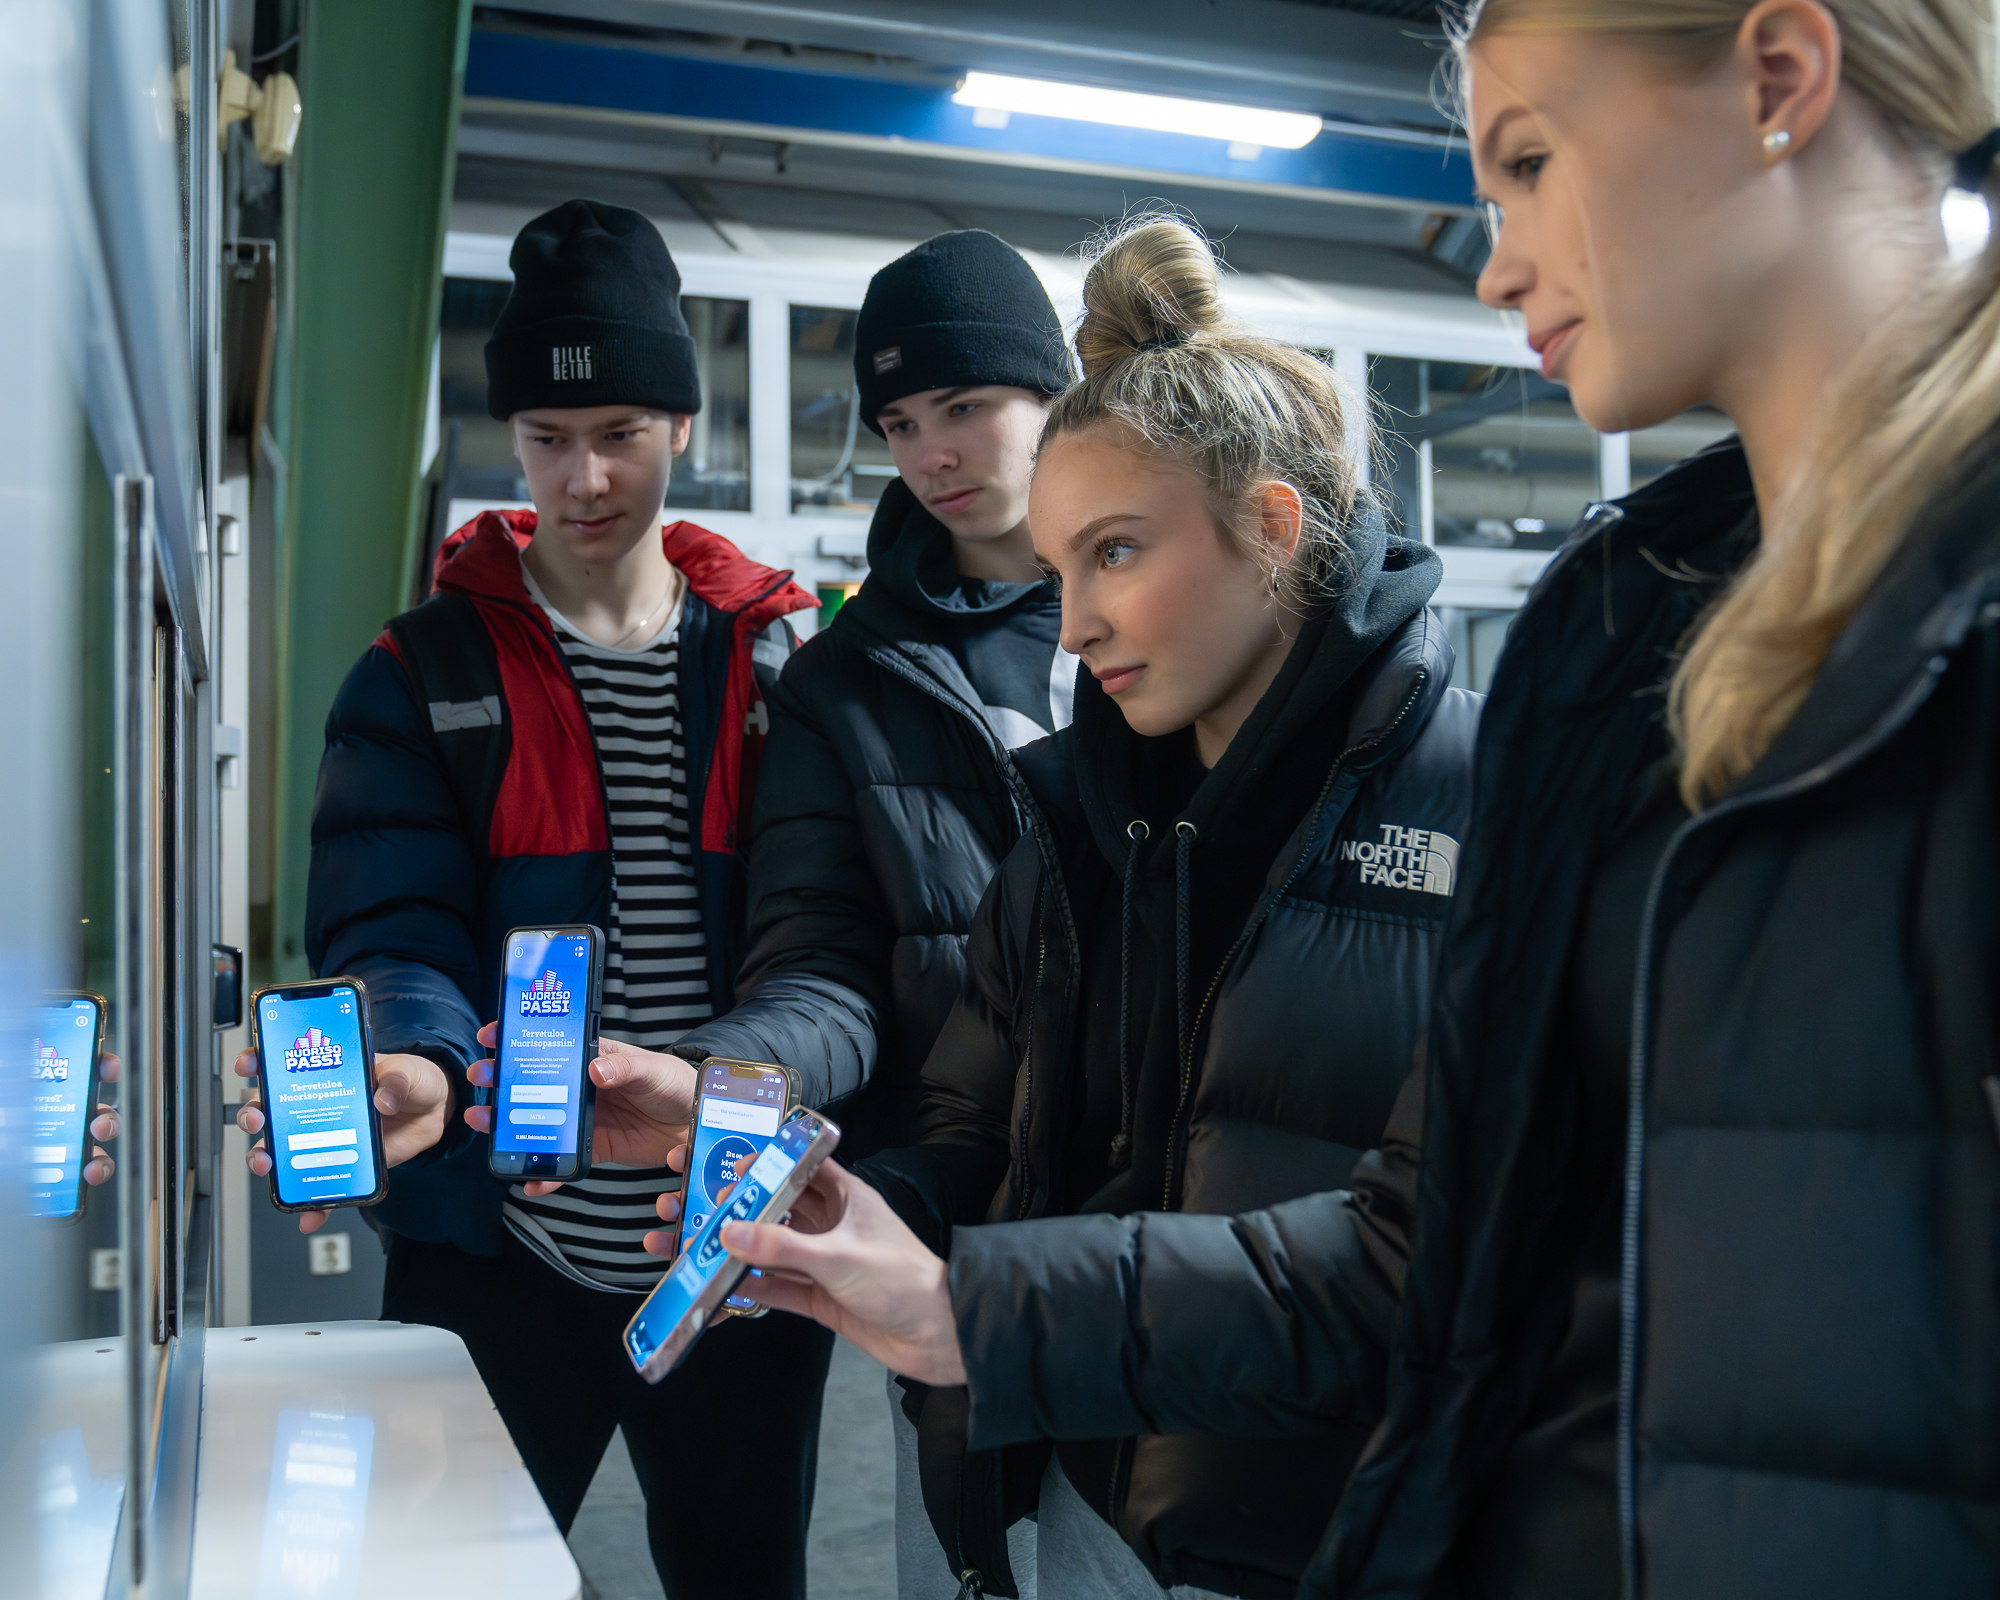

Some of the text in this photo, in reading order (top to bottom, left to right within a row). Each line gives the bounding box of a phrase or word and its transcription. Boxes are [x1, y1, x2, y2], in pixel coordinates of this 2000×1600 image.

[553, 346, 591, 364] BILLE
[1379, 824, 1430, 850] THE
[1341, 841, 1427, 870] NORTH
[1360, 862, 1424, 891] FACE
[521, 991, 571, 1001] NUORISO
[520, 1000, 570, 1014] PASSI
[522, 1029, 565, 1038] Tervetuloa
[510, 1038, 575, 1049] Nuorisopassiin!
[285, 1044, 342, 1059] NUORISO
[286, 1053, 343, 1071] PASSI
[290, 1080, 343, 1093] Tervetuloa
[279, 1087, 356, 1103] Nuorisopassiin!
